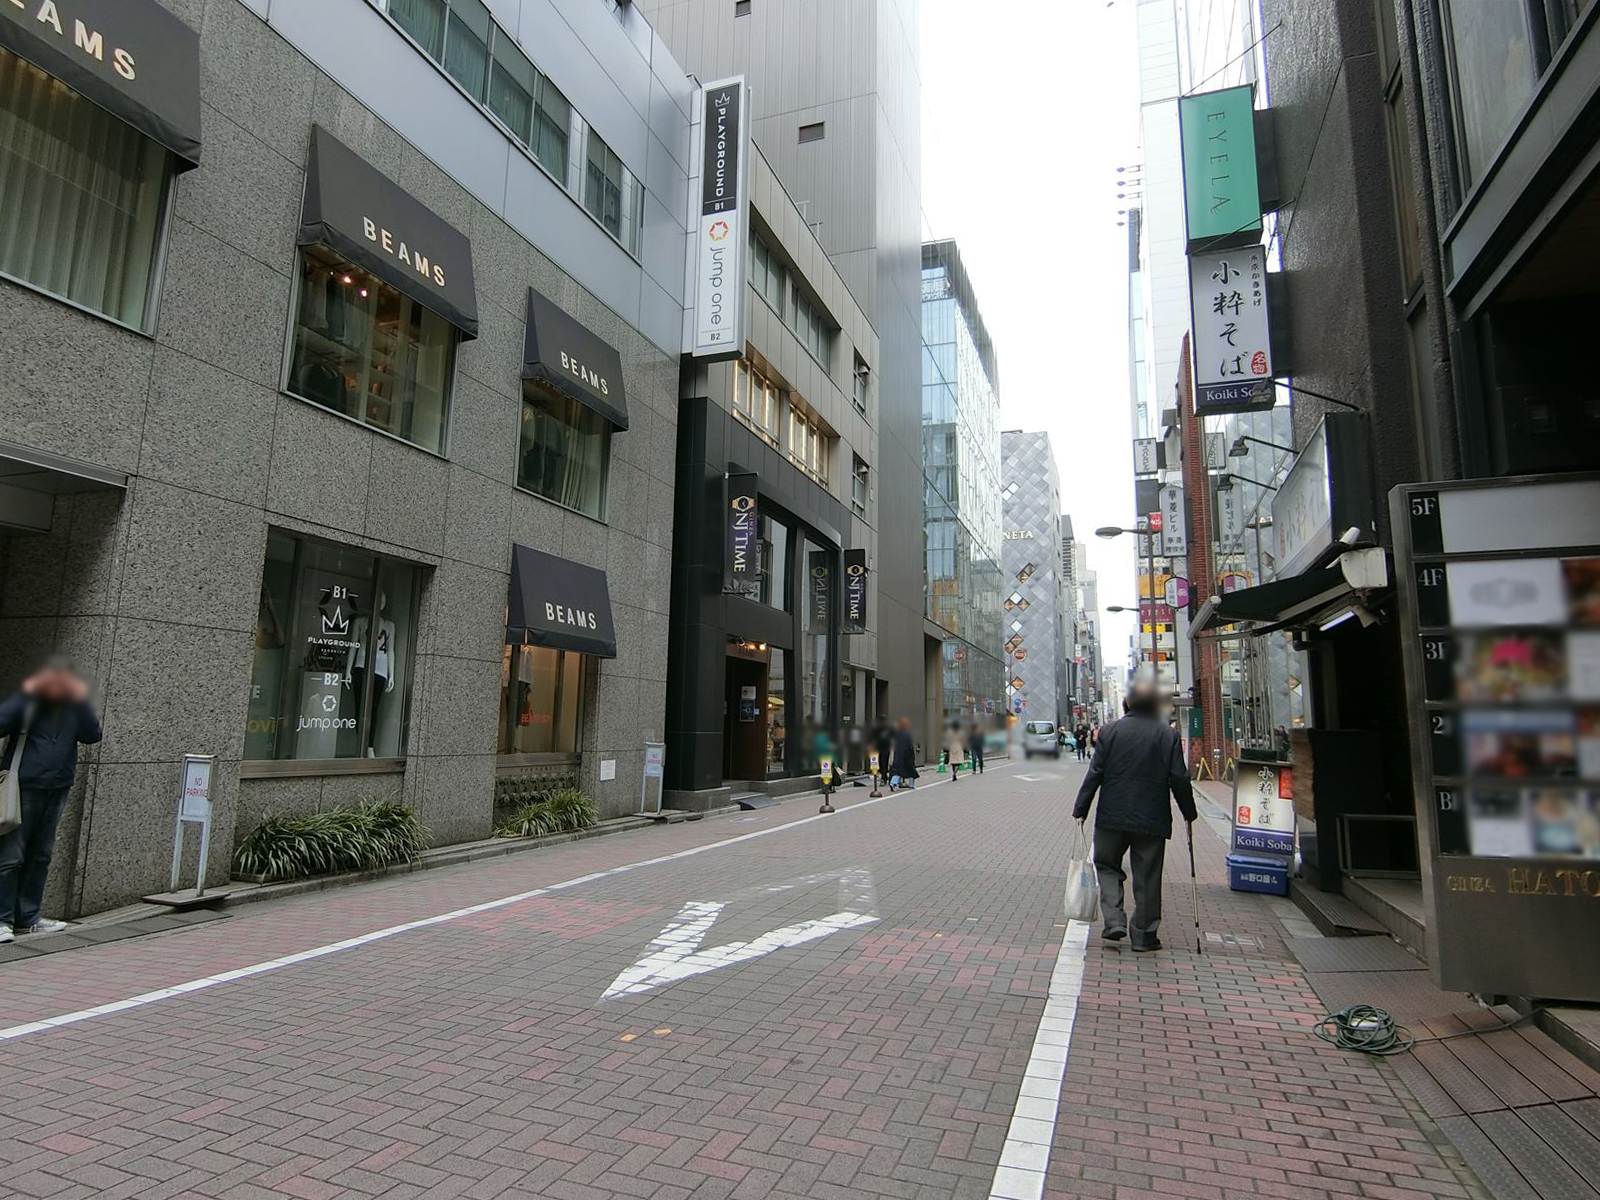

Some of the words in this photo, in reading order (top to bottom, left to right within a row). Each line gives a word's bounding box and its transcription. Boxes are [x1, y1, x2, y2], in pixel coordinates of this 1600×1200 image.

[9, 0, 136, 80] AMS
[715, 107, 727, 197] PLAYGROUND
[714, 202, 724, 211] B1
[363, 216, 446, 287] BEAMS
[708, 247, 726, 288] jump
[710, 293, 722, 325] one
[1212, 260, 1248, 377] 小粋そば
[710, 333, 721, 341] B2
[560, 351, 609, 395] BEAMS
[1206, 389, 1238, 401] Koiki
[1412, 497, 1436, 515] 5F
[733, 533, 749, 572] TIME
[1418, 568, 1444, 586] 4F
[333, 585, 347, 599] B1
[849, 591, 860, 619] TIME
[545, 602, 597, 630] BEAMS
[307, 636, 361, 649] PLAYGROUND
[324, 673, 339, 686] B2
[296, 715, 331, 732] jump
[332, 717, 357, 729] one
[1257, 766, 1275, 826] 小粋そば
[1236, 835, 1265, 848] Koiki
[1267, 839, 1293, 852] Soba
